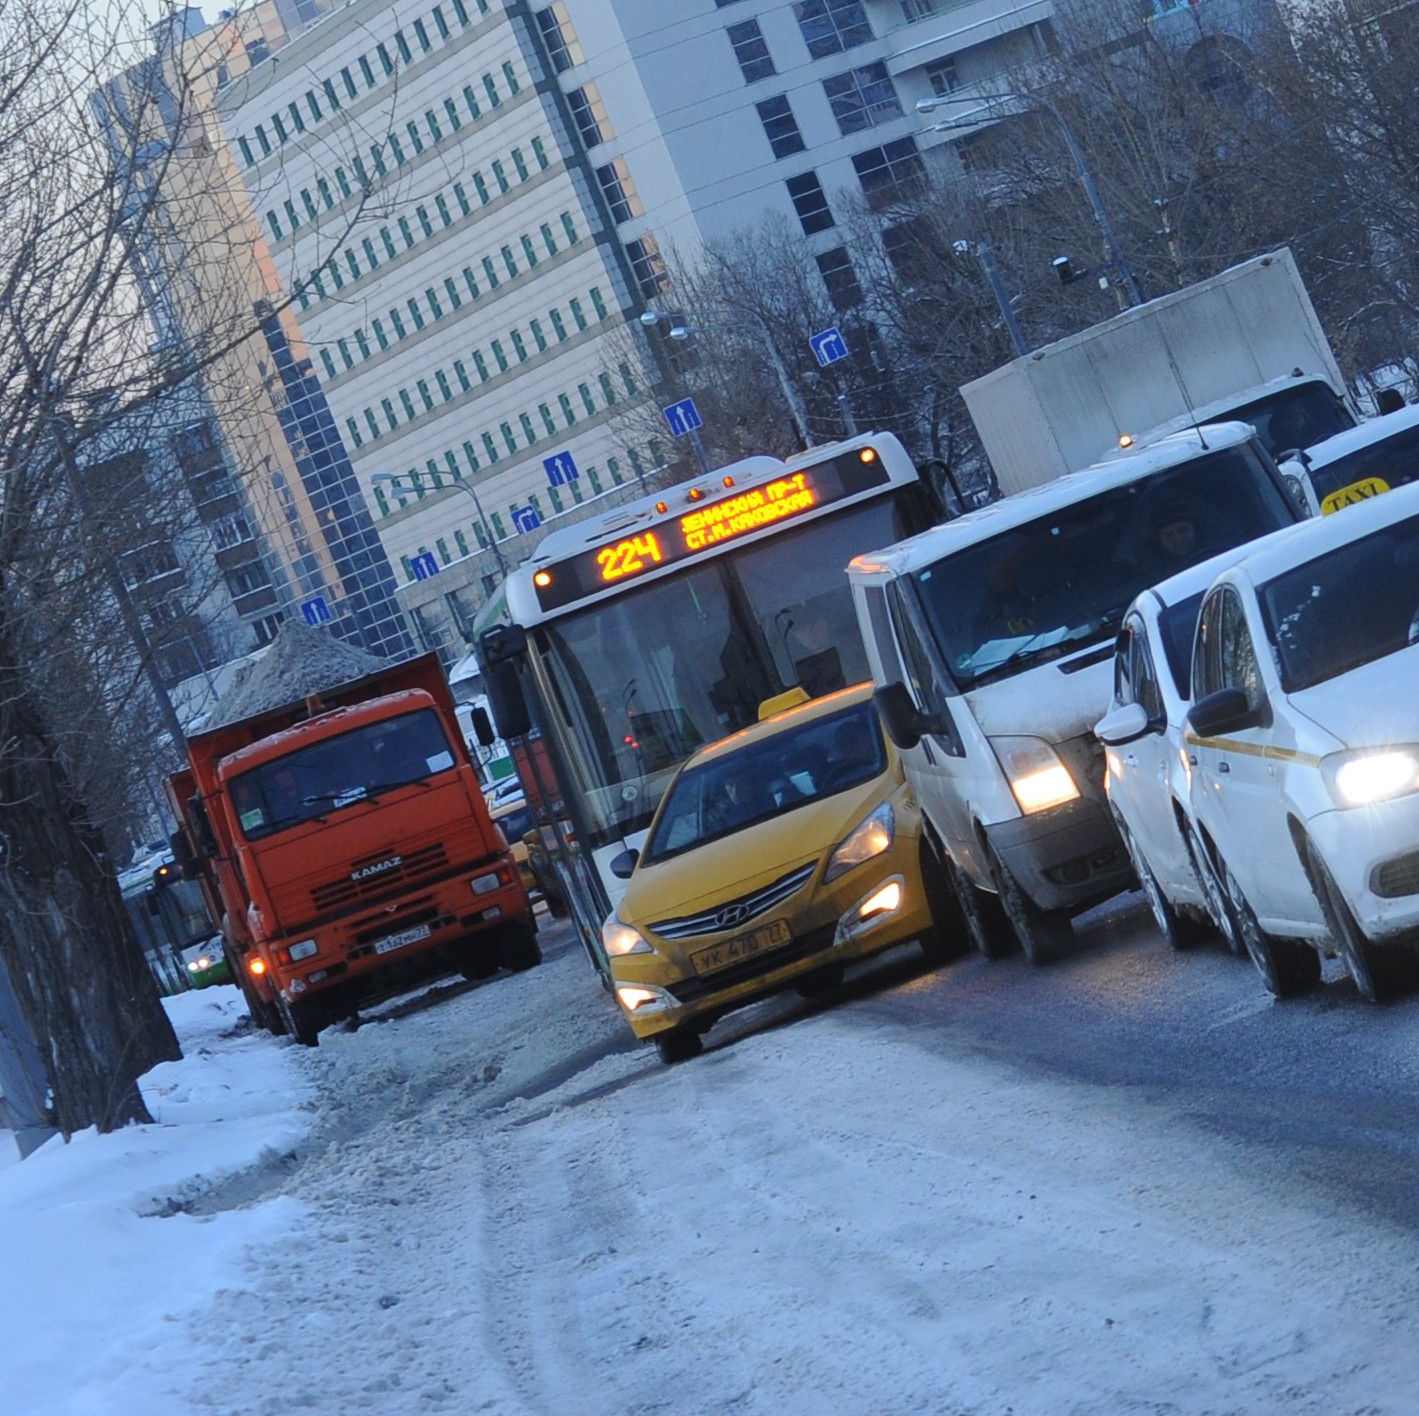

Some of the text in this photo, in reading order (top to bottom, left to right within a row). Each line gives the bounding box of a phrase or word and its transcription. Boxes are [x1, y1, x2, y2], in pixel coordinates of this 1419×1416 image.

[1327, 482, 1379, 512] TAXI
[597, 532, 662, 581] 224
[351, 856, 402, 881] KAMAZ
